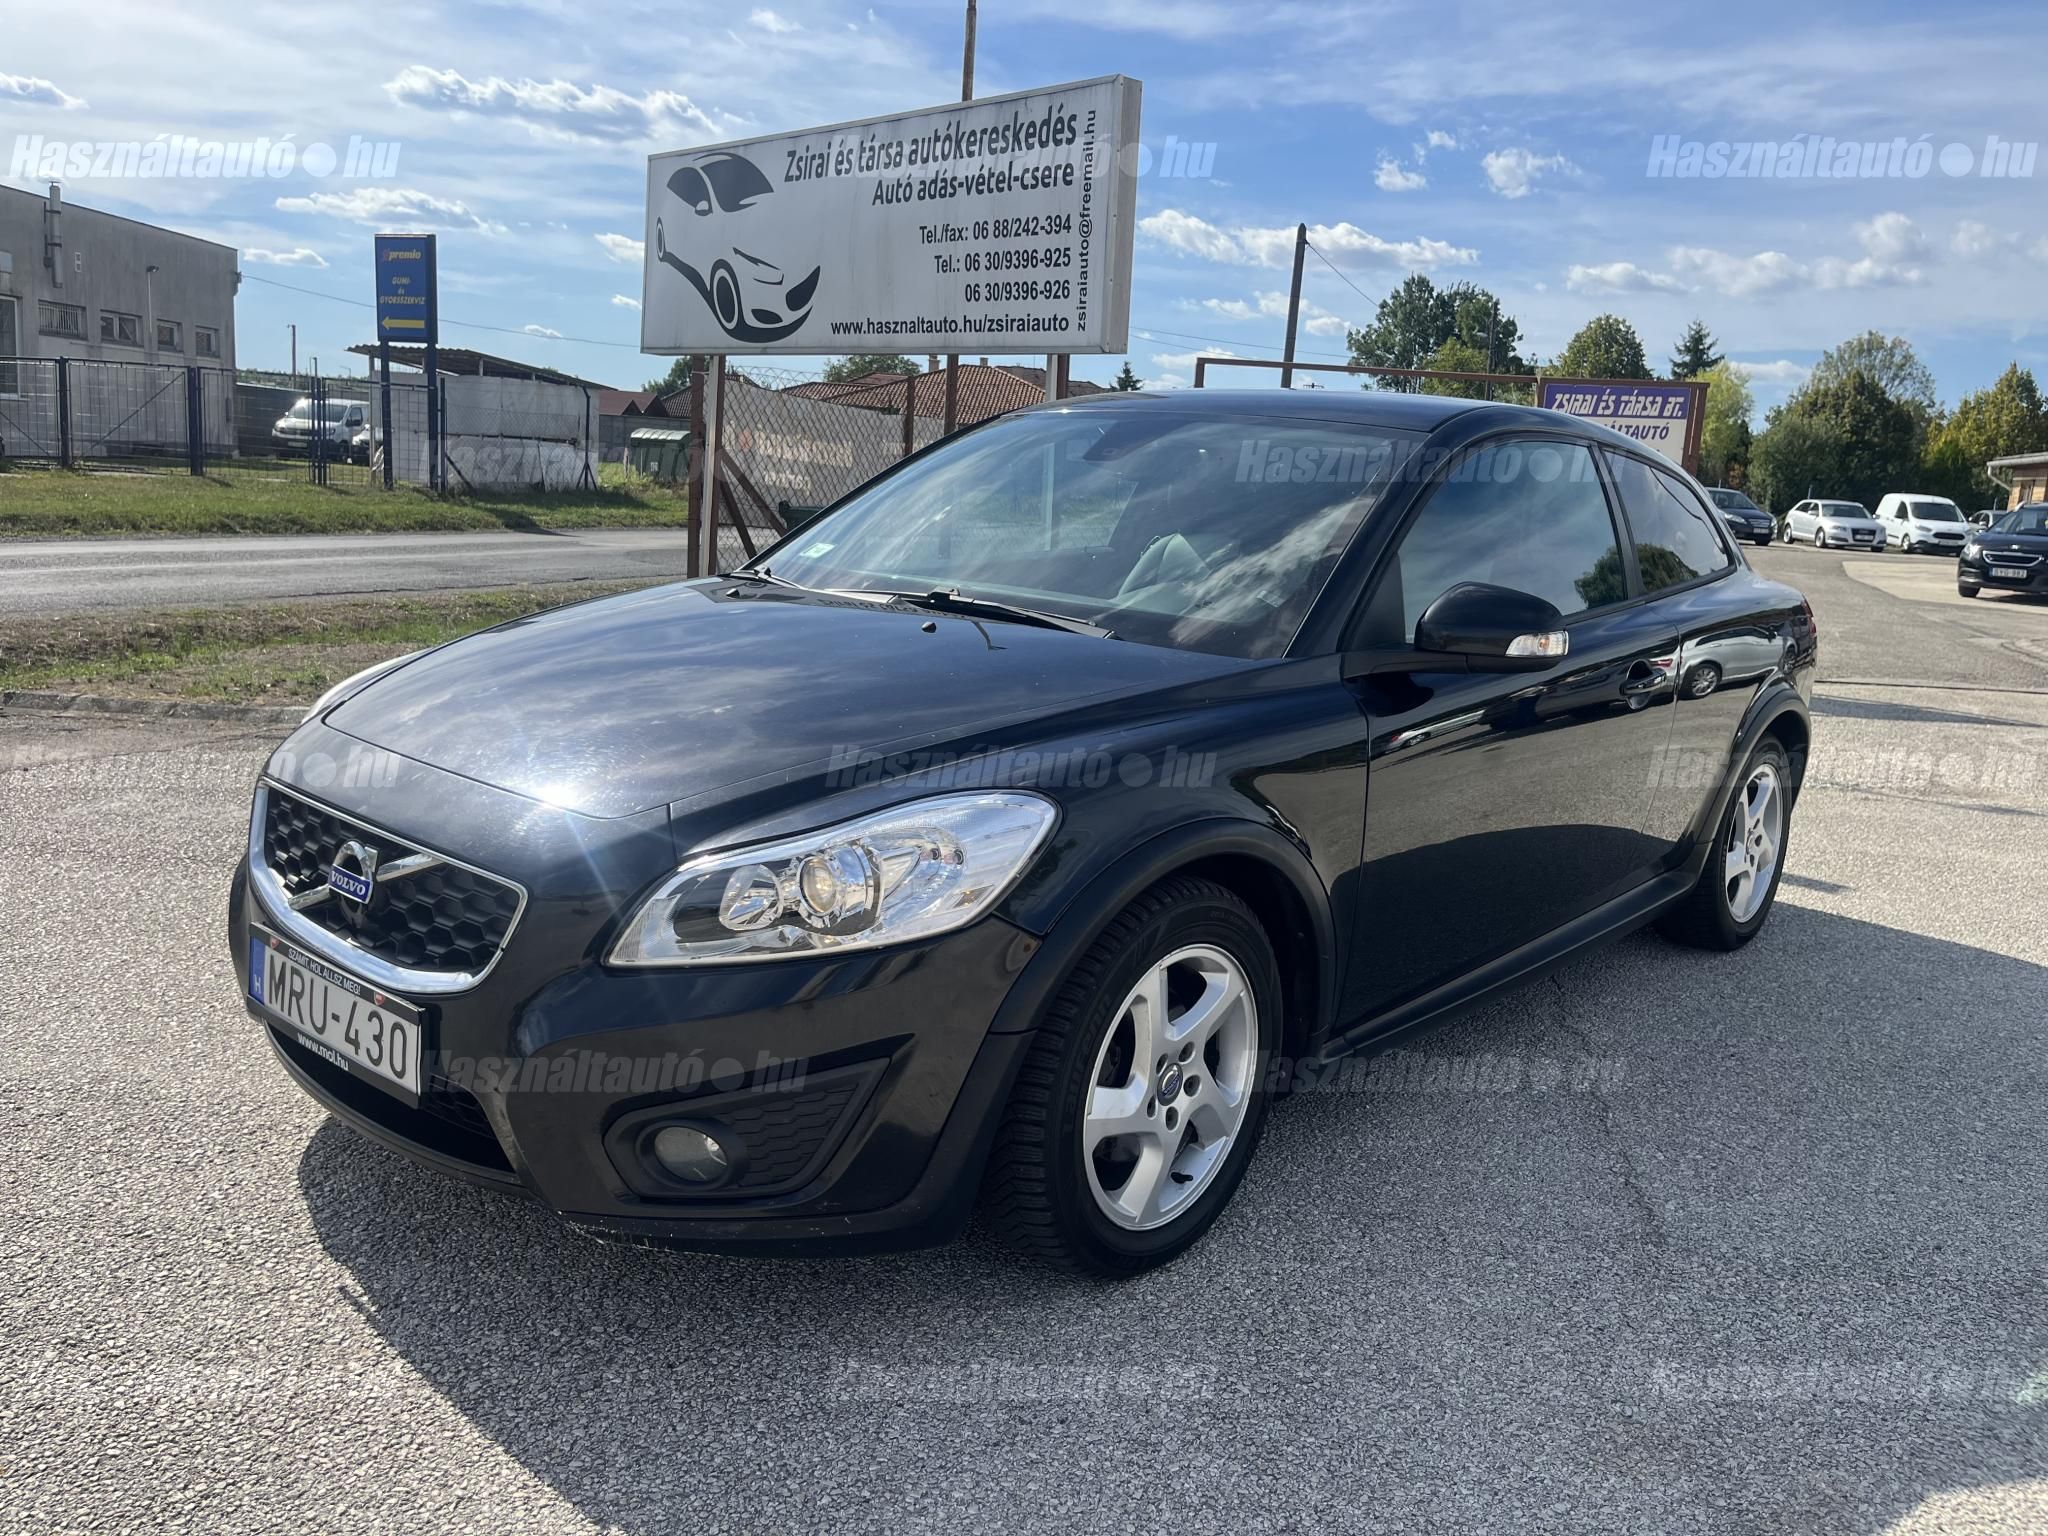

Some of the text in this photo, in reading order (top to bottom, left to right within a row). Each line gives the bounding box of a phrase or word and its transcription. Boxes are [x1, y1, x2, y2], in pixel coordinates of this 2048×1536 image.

[784, 102, 1077, 182] Zsirai és társa autókereskedés
[872, 160, 1074, 206] Autó adás-vétel-csere
[919, 214, 1072, 244] Tel./fax: 06 88/242-394
[1076, 110, 1097, 332] zsiraiauto@freemail.hu
[388, 249, 422, 261] premio
[934, 247, 1071, 273] Tel.: 06 30/9396-925
[965, 279, 1071, 302] 06 30/9396-926
[830, 313, 1069, 335] www.hasznaltauto.hu/zsiraiauto
[1597, 388, 1616, 415] ÉS
[1618, 389, 1662, 417] TÁRSA
[1663, 396, 1685, 417] BT.
[331, 870, 366, 896] VOLVO
[269, 954, 408, 1080] MRU-430
[297, 1033, 349, 1071] www.mol.hu
